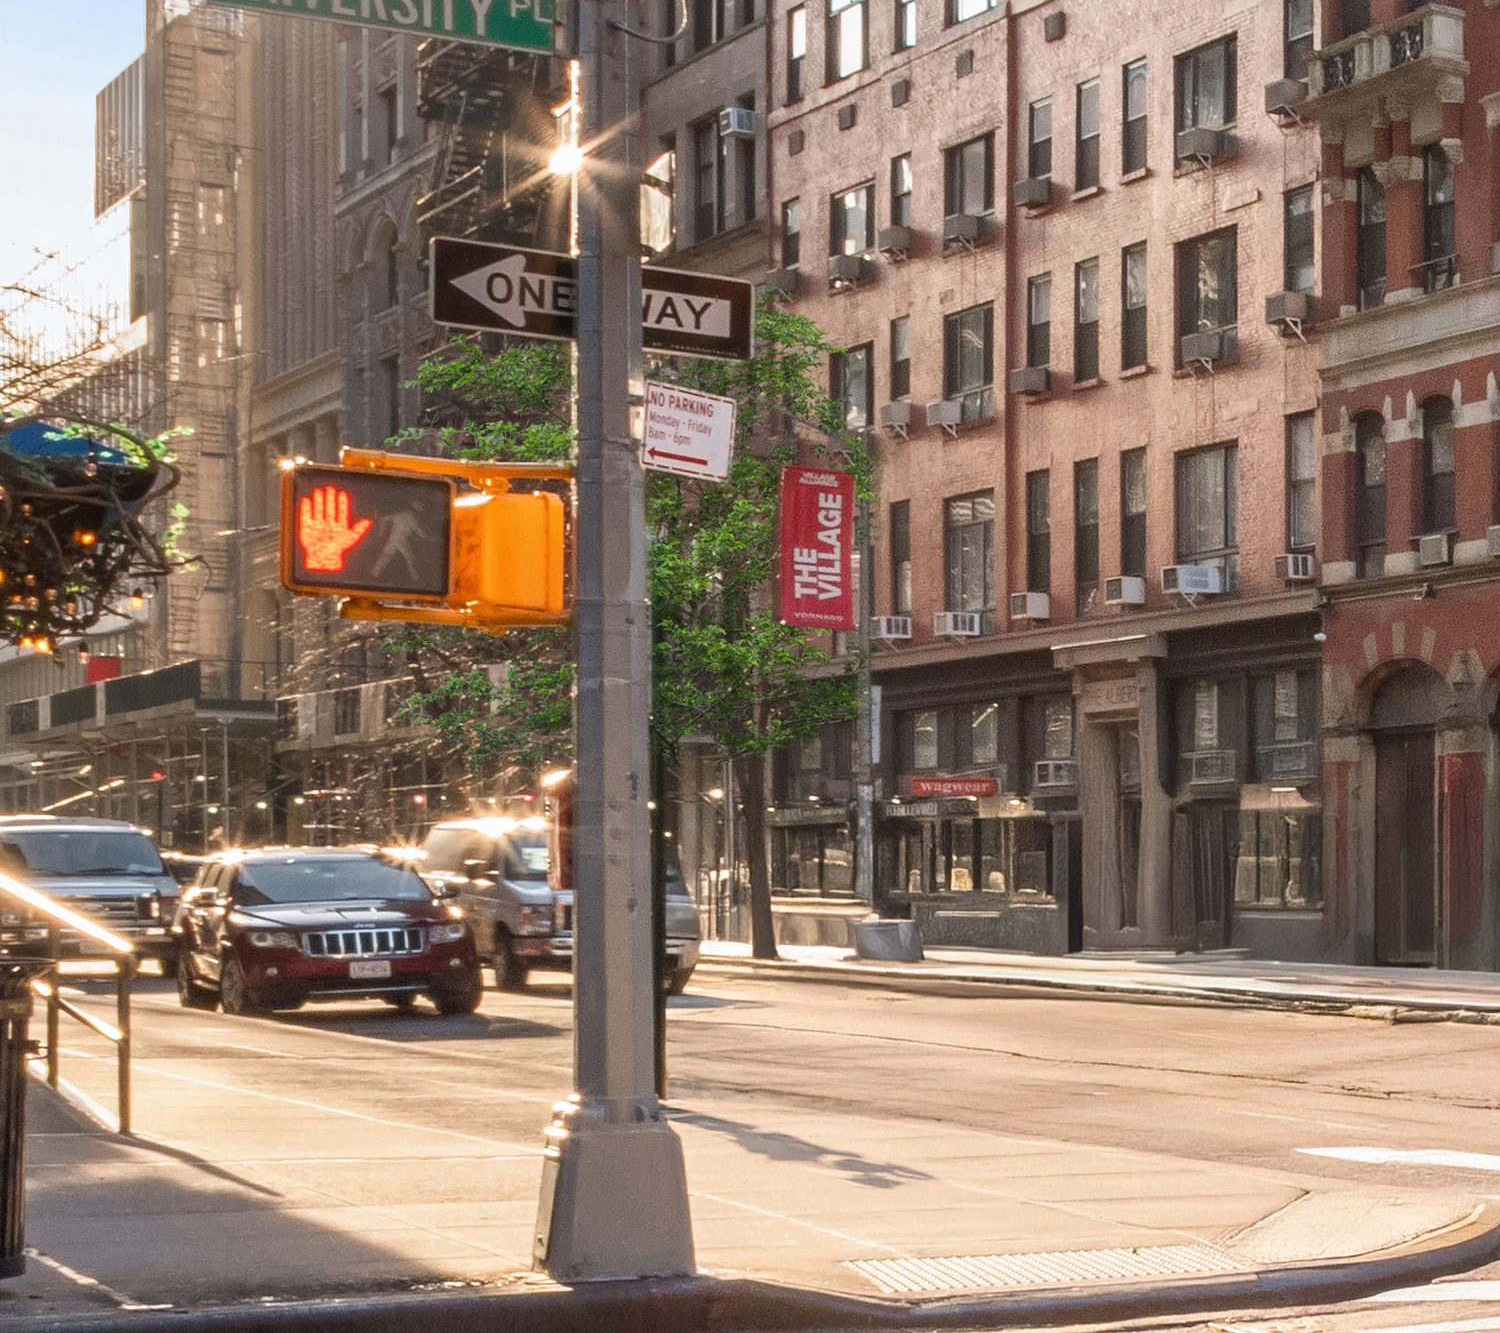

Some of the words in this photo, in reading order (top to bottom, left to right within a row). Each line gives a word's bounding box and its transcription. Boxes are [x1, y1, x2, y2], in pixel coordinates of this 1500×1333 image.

[486, 272, 575, 314] ONE
[650, 391, 665, 407] NO
[668, 394, 714, 418] PARKING
[649, 411, 680, 431] Monday
[688, 418, 712, 438] Friday
[817, 492, 842, 601] VILLAGE
[793, 547, 818, 600] THE
[919, 781, 991, 794] wagwear
